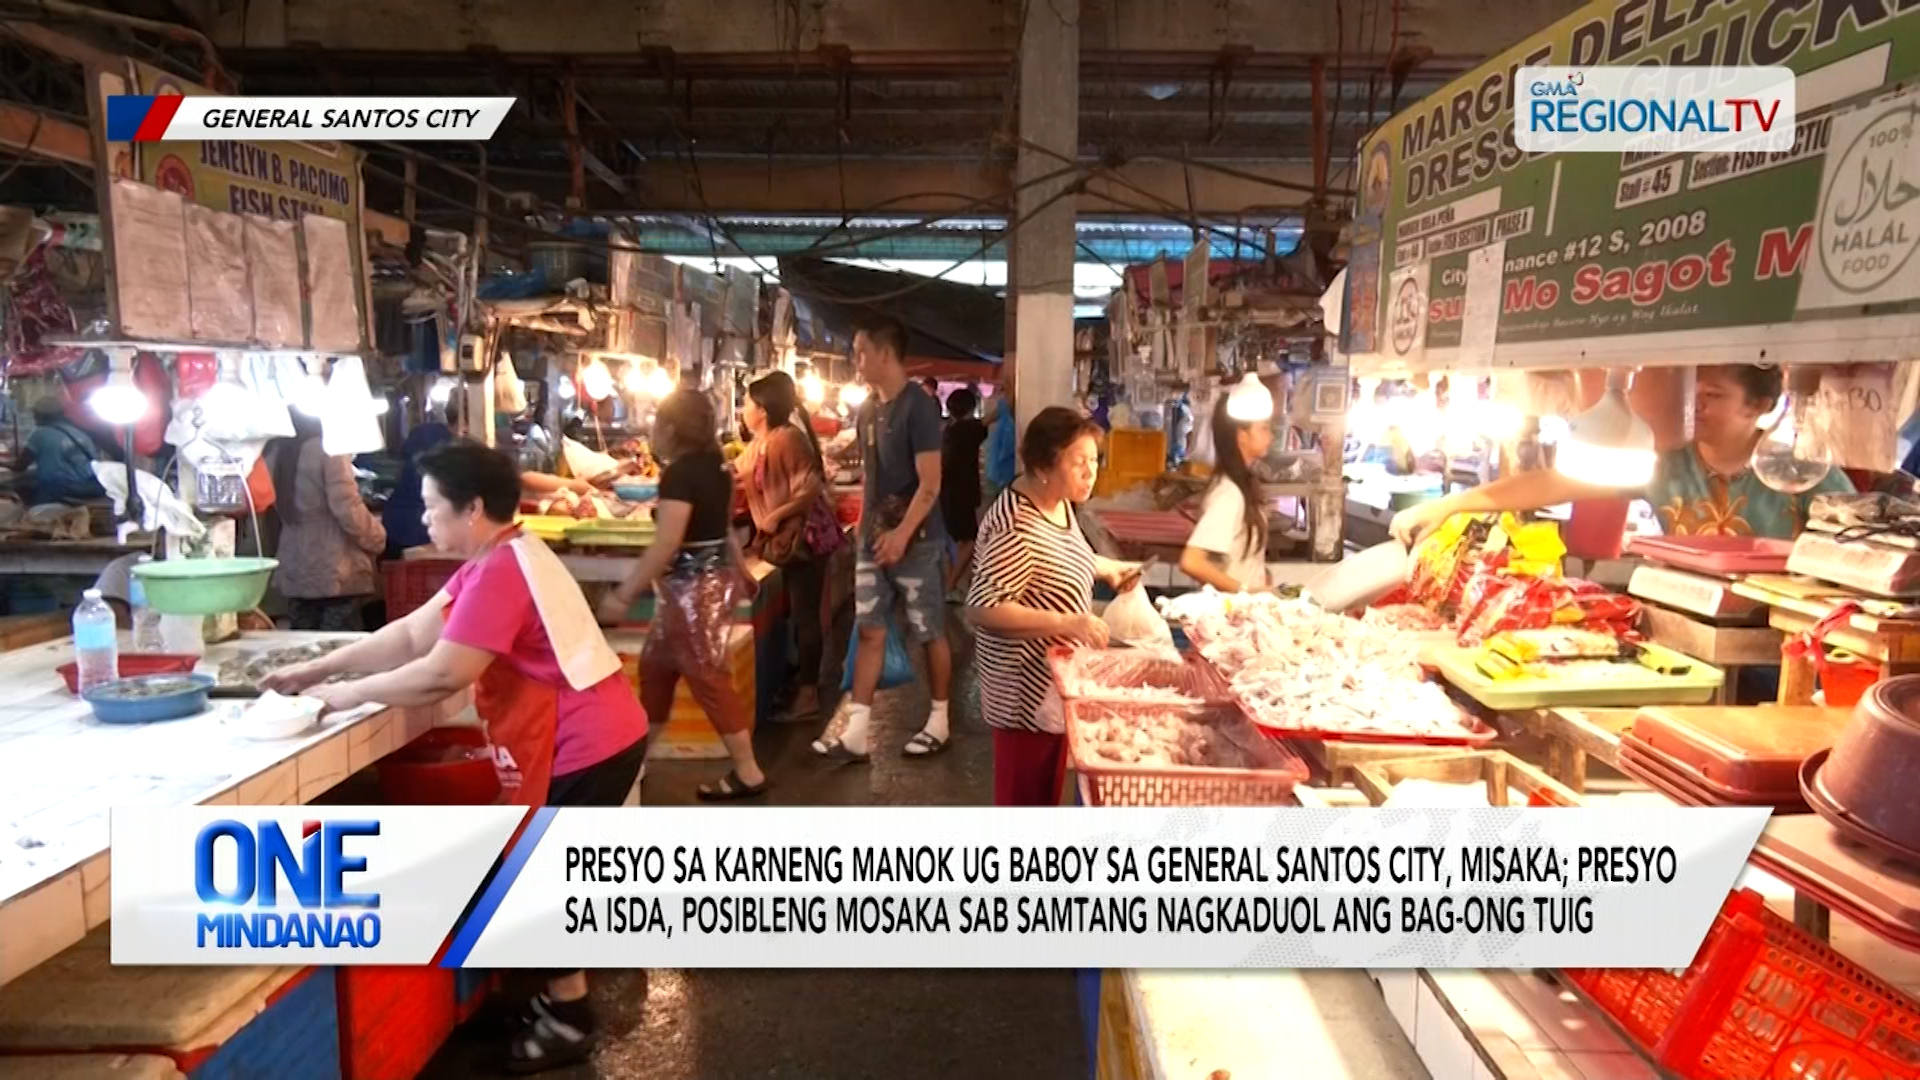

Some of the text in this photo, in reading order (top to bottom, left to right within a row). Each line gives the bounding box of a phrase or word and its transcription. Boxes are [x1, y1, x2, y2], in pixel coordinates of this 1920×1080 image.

[1406, 0, 1920, 206] DRESS CHICK
[200, 139, 268, 180] JENELYN
[271, 152, 287, 186] B.
[289, 158, 350, 206] PACOMO
[1651, 165, 1672, 195] 45
[1769, 116, 1834, 163] SECTIO
[229, 184, 274, 216] FISH
[1831, 218, 1910, 254] HALAL
[1441, 267, 1467, 289] City
[1504, 249, 1559, 273] nance
[1563, 235, 1602, 262] #12
[1638, 210, 1708, 247] 2008
[1503, 275, 1560, 314] Mo
[1571, 239, 1736, 306] Sagot
[1754, 222, 1815, 280] M
[1841, 252, 1891, 275] FOOD
